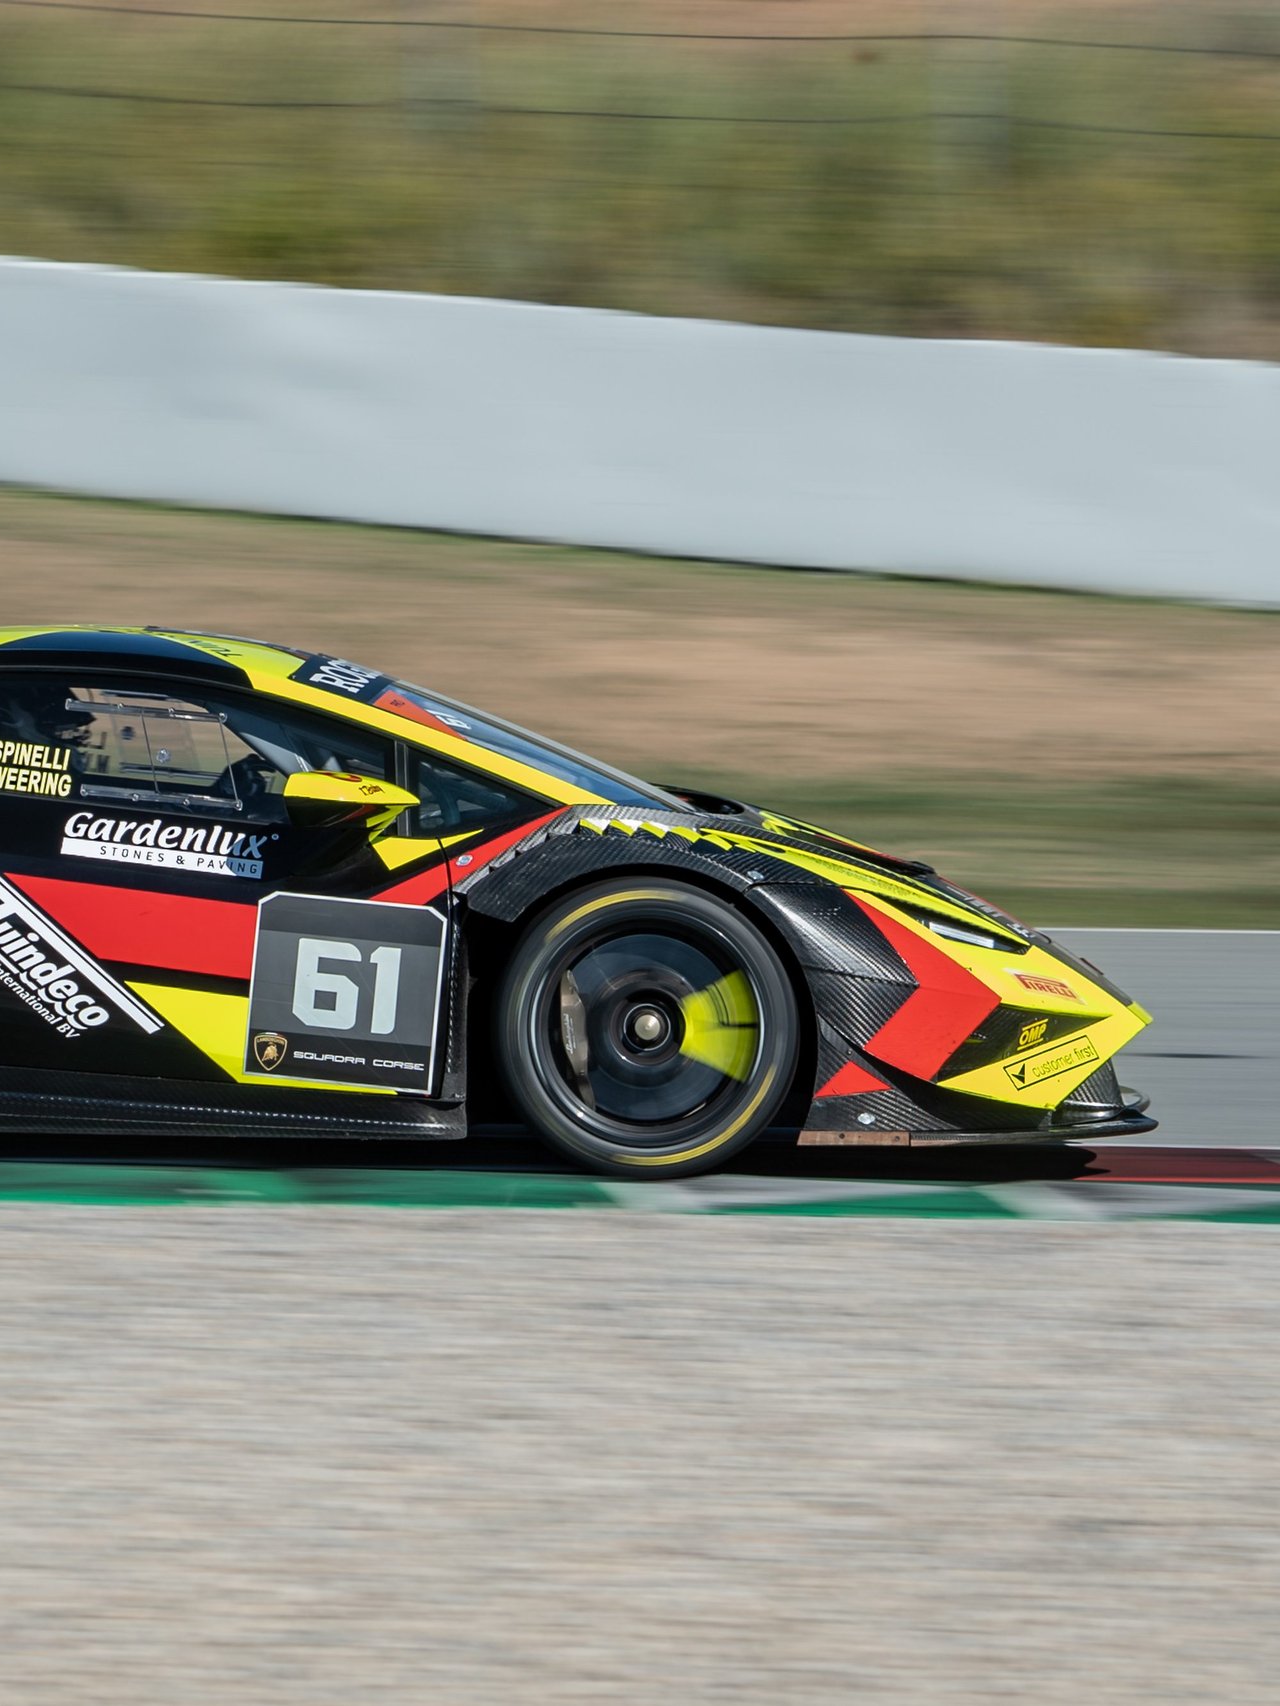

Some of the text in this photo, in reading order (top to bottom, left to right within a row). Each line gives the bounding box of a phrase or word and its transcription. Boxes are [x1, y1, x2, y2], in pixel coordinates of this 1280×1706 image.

[64, 812, 268, 860] Gardenlux
[100, 846, 258, 875] STONES & PAVING
[292, 938, 402, 1035] 61
[1014, 973, 1078, 999] PIRELLI
[56, 1019, 80, 1039] BV
[1019, 1023, 1047, 1046] OMP
[293, 1050, 424, 1071] SQUADRA CORSE
[1032, 1045, 1095, 1077] customer first
